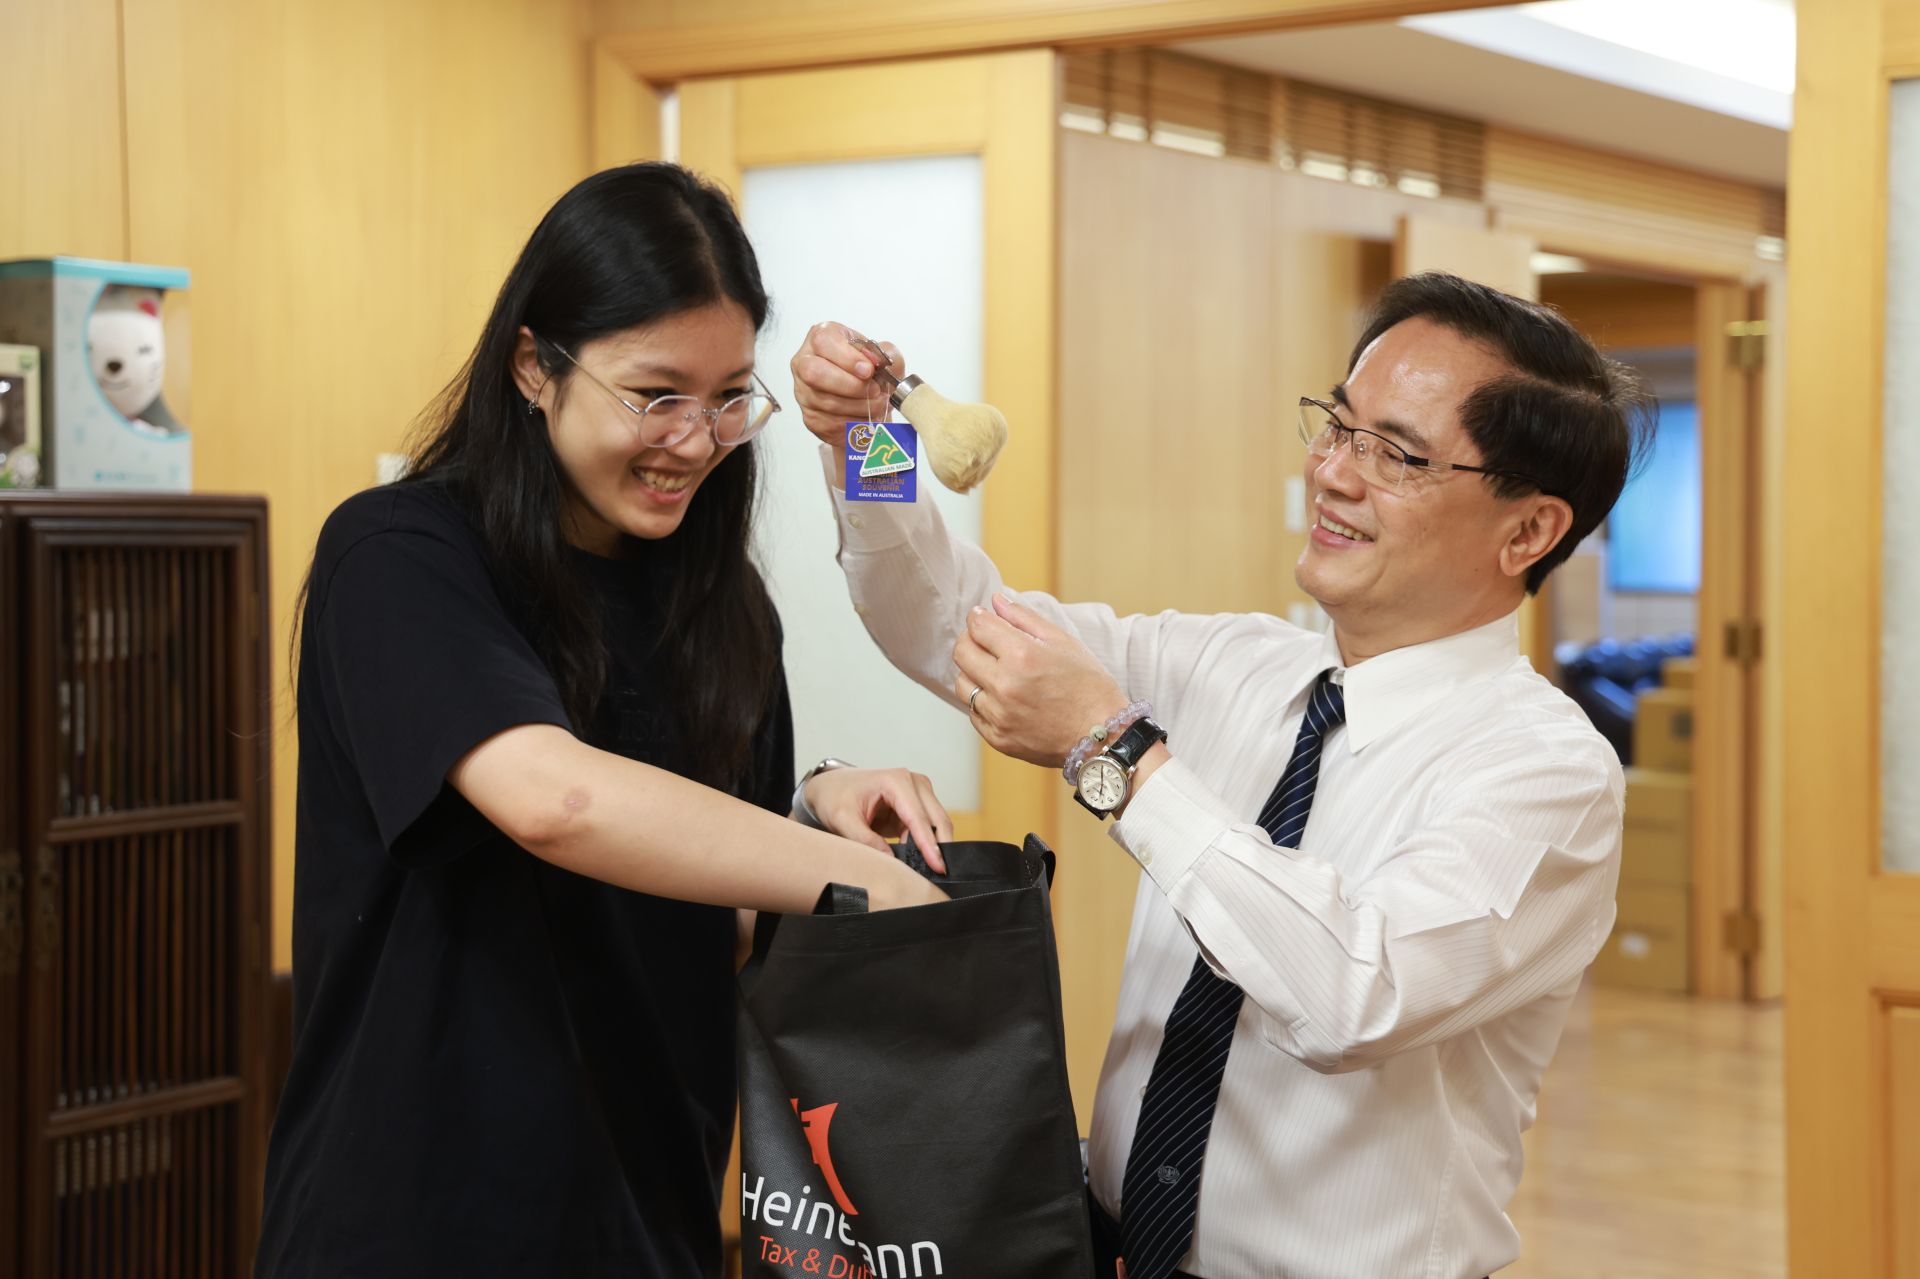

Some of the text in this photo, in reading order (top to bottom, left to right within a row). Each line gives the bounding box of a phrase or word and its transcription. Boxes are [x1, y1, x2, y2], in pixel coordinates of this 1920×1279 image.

[858, 477, 904, 485] AUSTRALIAN
[862, 466, 895, 475] AUSTRALIAN
[742, 1172, 943, 1279] Heineann
[760, 1235, 796, 1269] Tax
[802, 1248, 821, 1275] &
